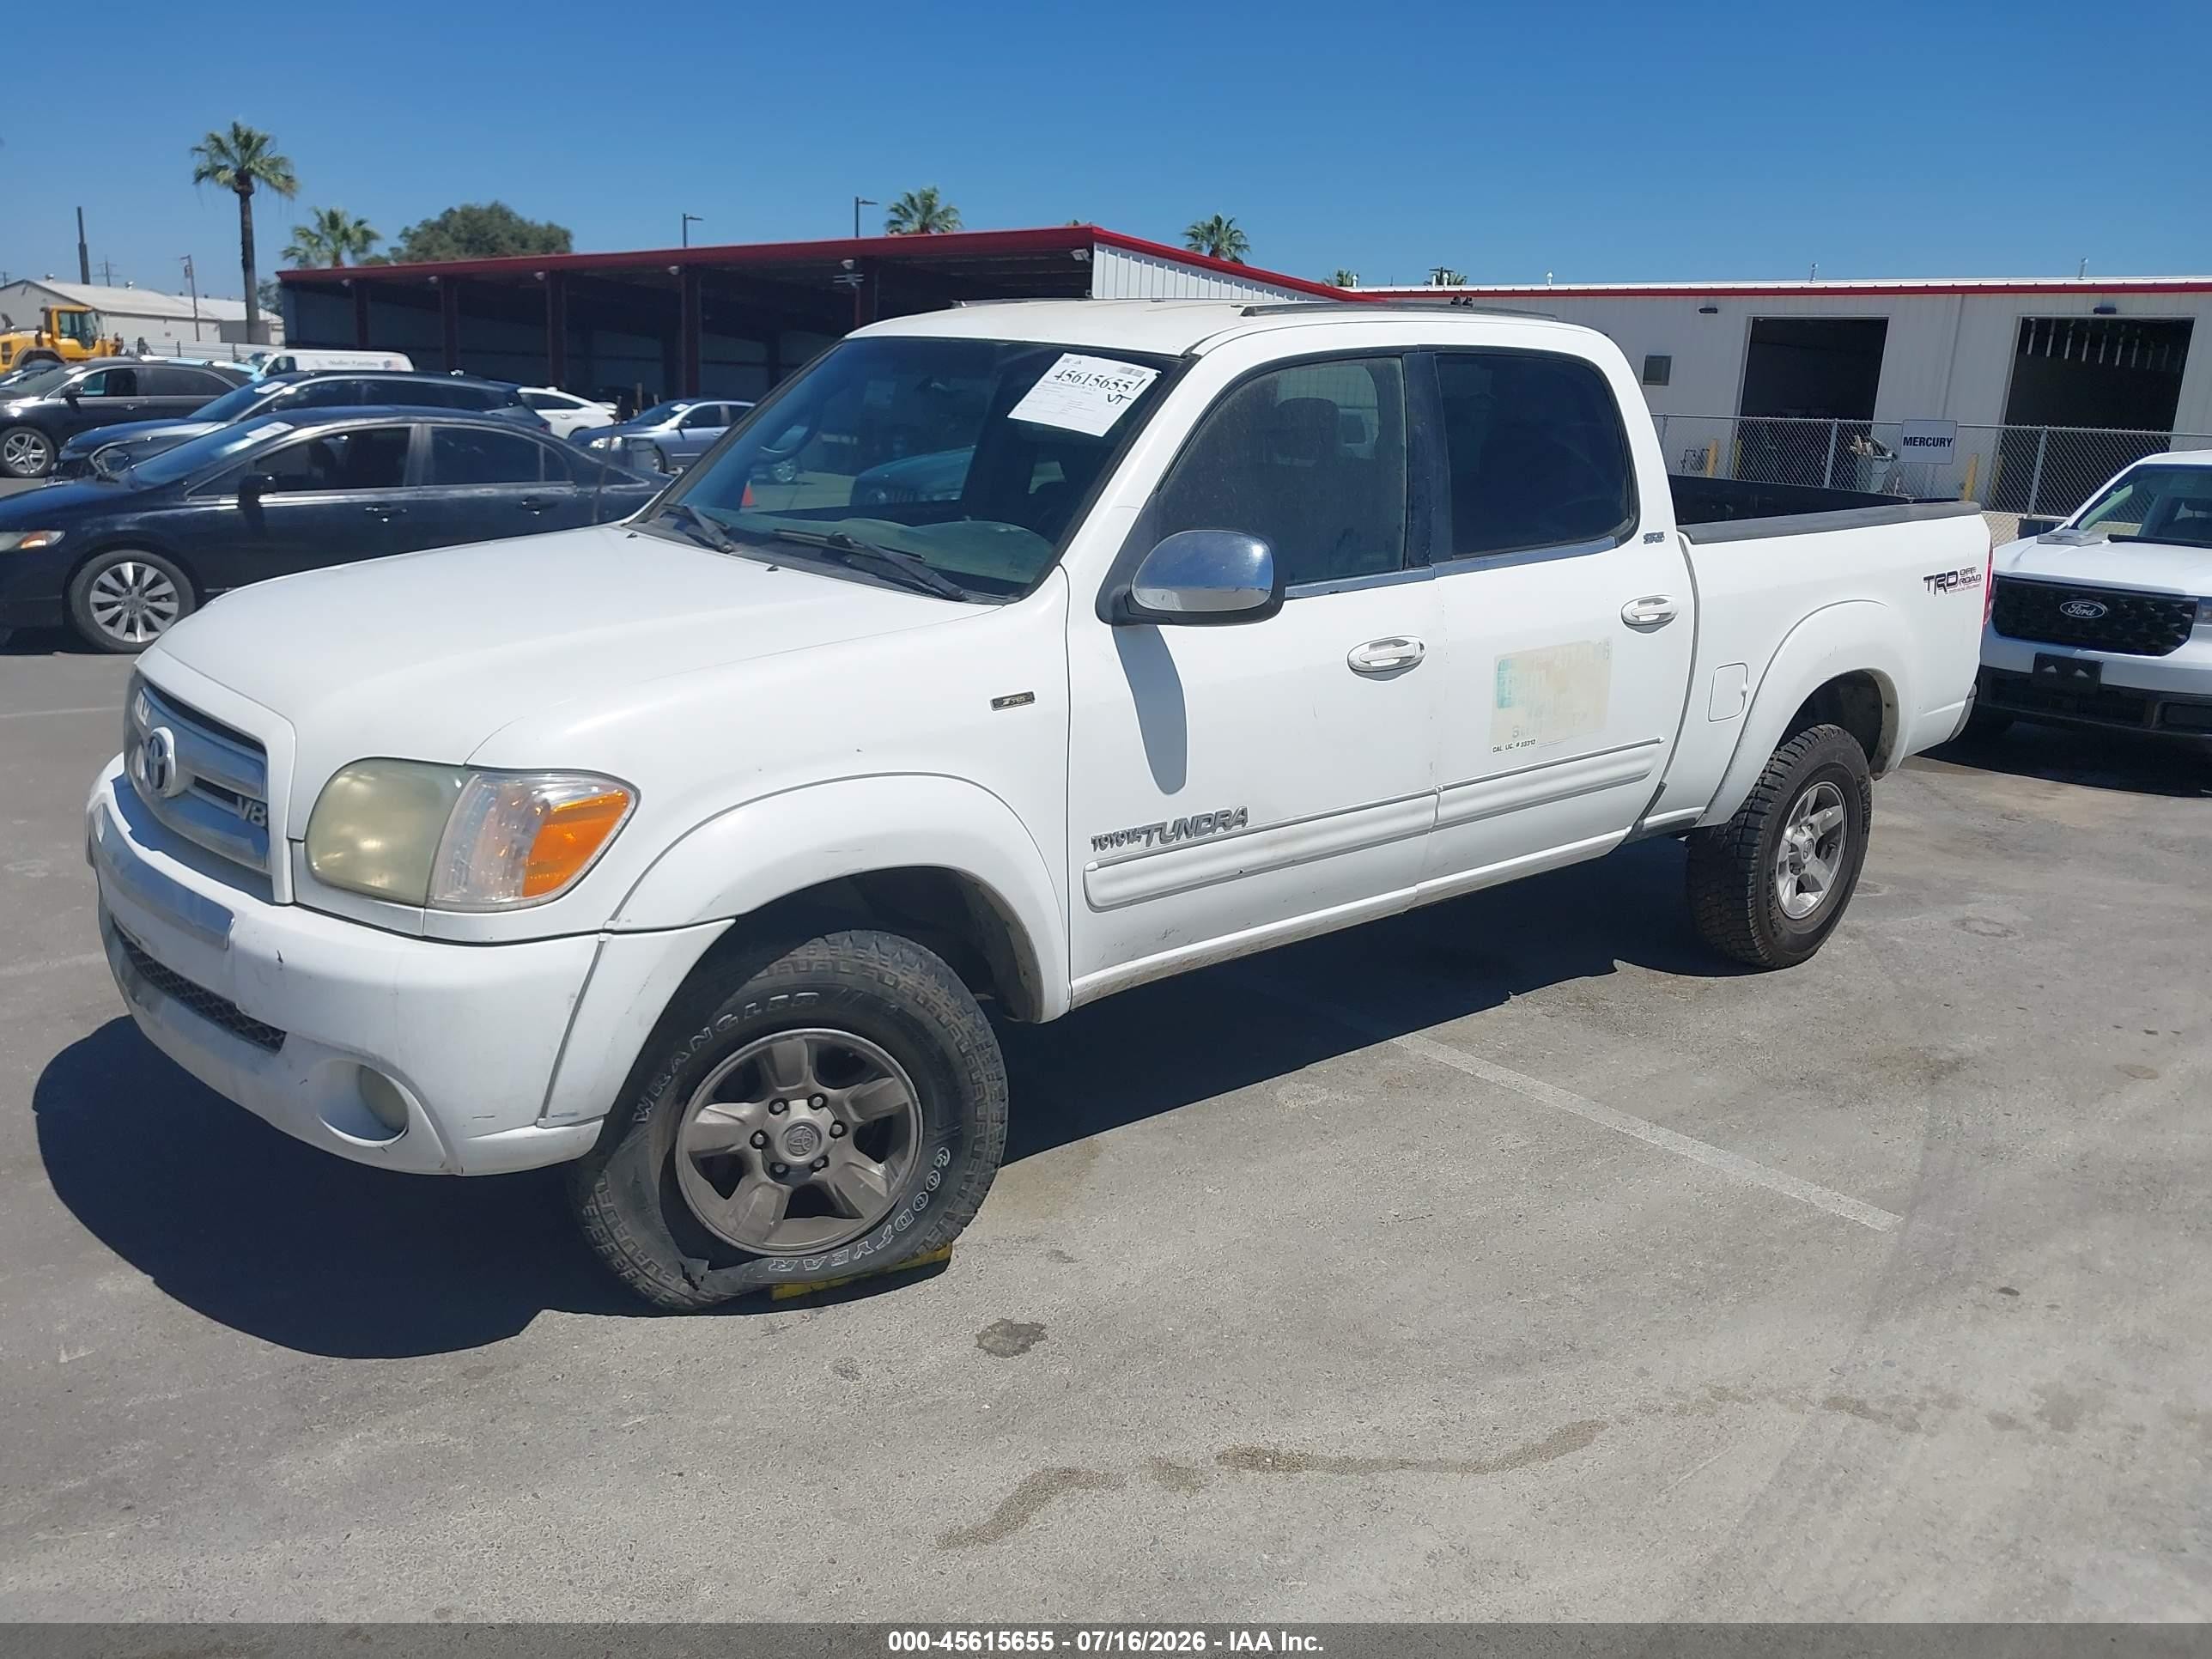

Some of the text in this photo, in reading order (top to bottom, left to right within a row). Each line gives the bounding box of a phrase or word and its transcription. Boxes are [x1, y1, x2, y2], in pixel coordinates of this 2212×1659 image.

[1054, 368, 1133, 393] 45615655
[1902, 436, 1954, 447] MERCURY
[1923, 570, 1959, 595] TRD
[1959, 566, 1977, 576] OFF
[1959, 574, 1982, 586] ROAD
[2067, 603, 2097, 617] Ford
[236, 795, 267, 828] V8
[1091, 805, 1249, 853] TOYOTA TUNDRA
[768, 1146, 951, 1273] GOODYEAR
